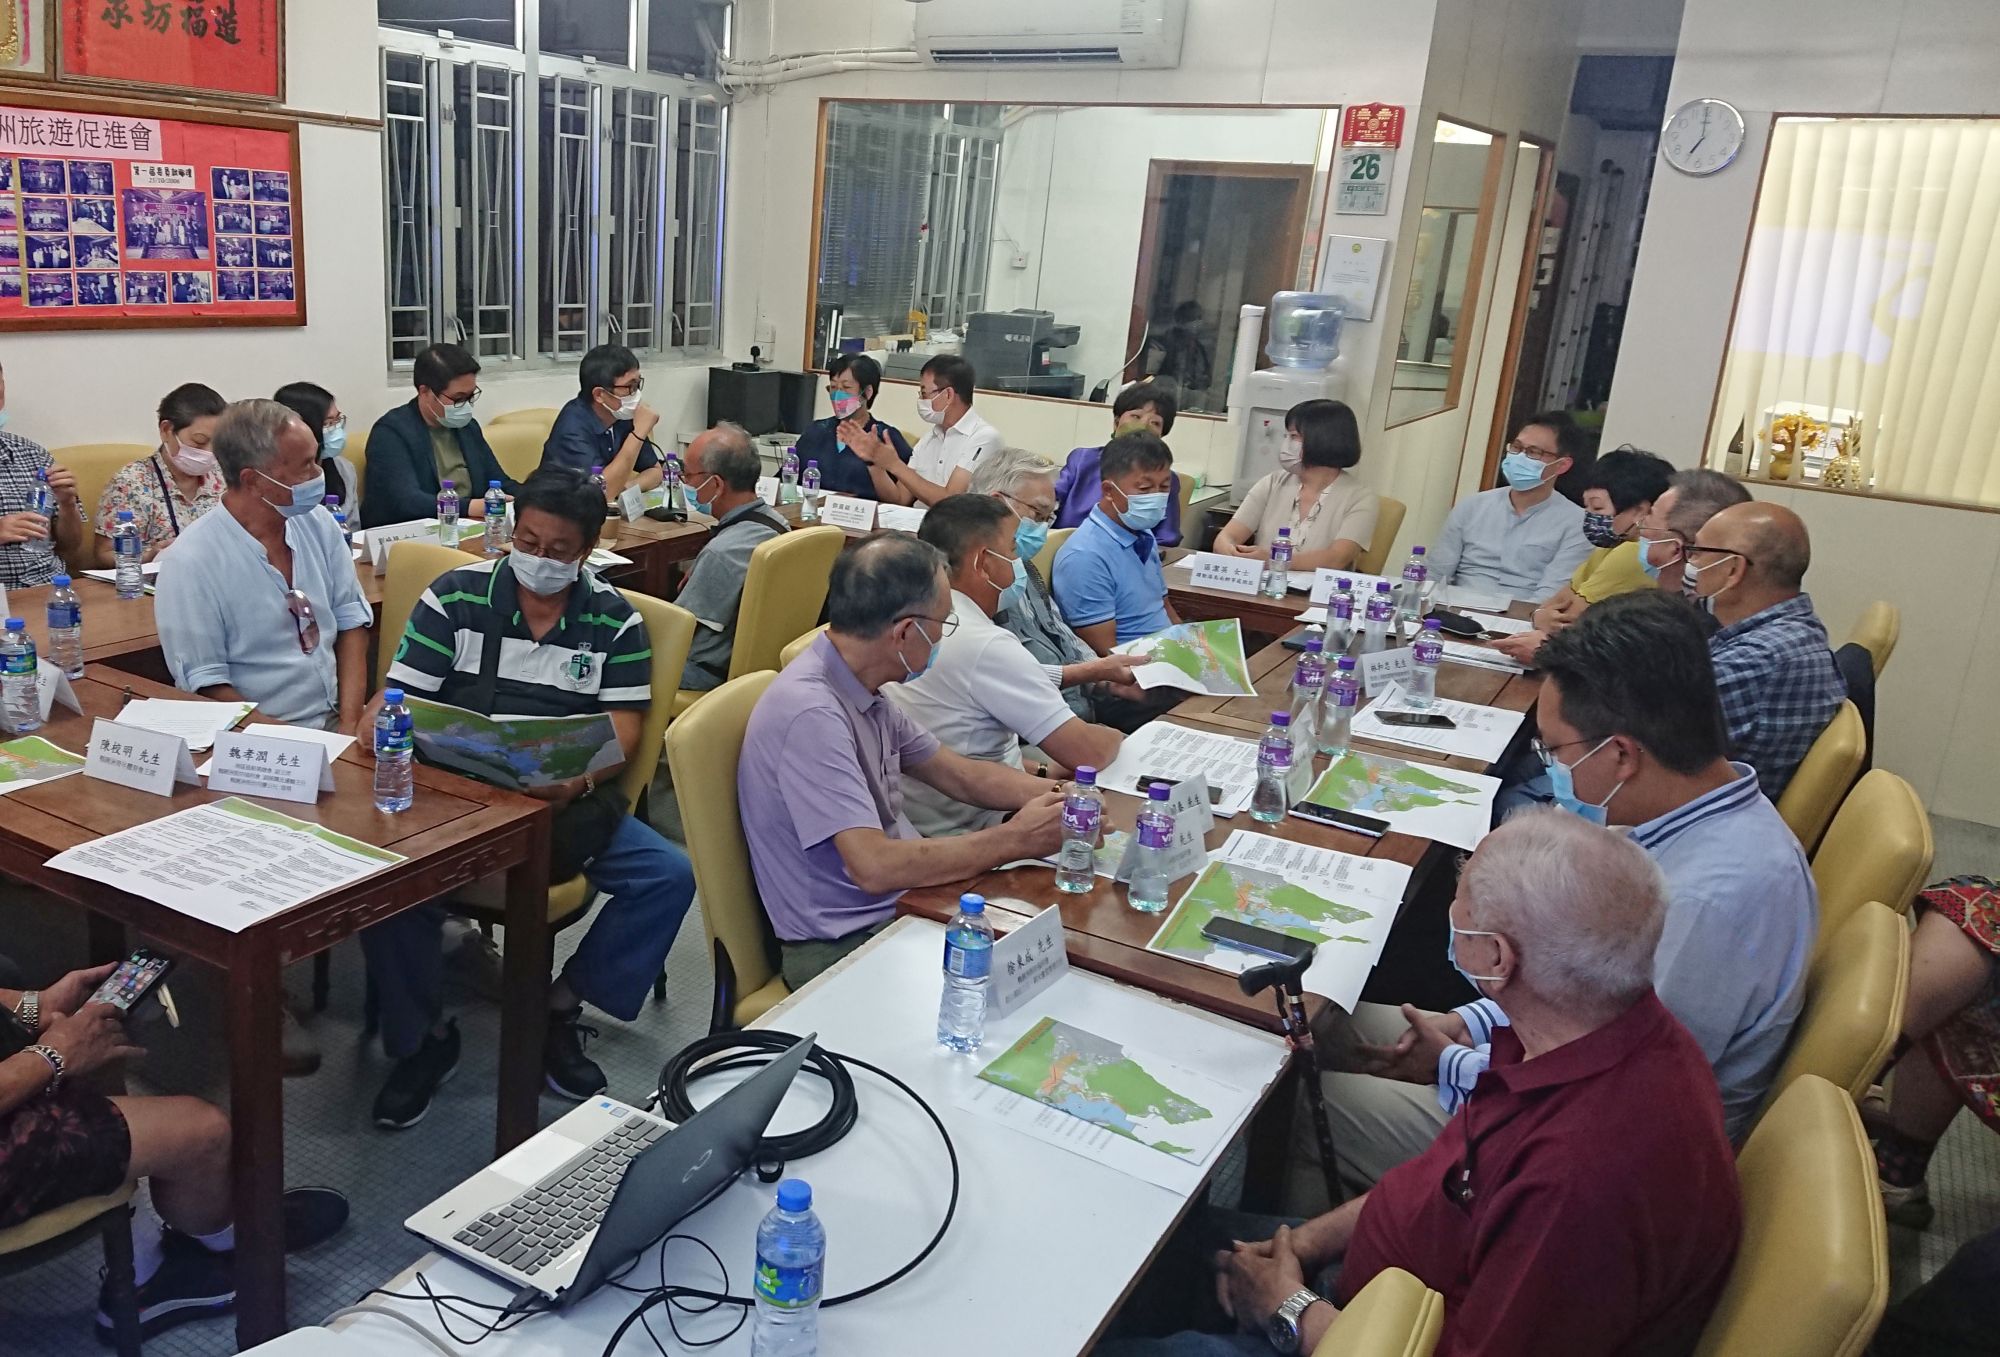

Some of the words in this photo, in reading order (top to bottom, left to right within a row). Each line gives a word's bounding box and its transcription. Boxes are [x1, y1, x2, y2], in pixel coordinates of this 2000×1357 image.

[1350, 153, 1381, 180] 26
[139, 749, 161, 766] 先生
[275, 752, 301, 768] 先生
